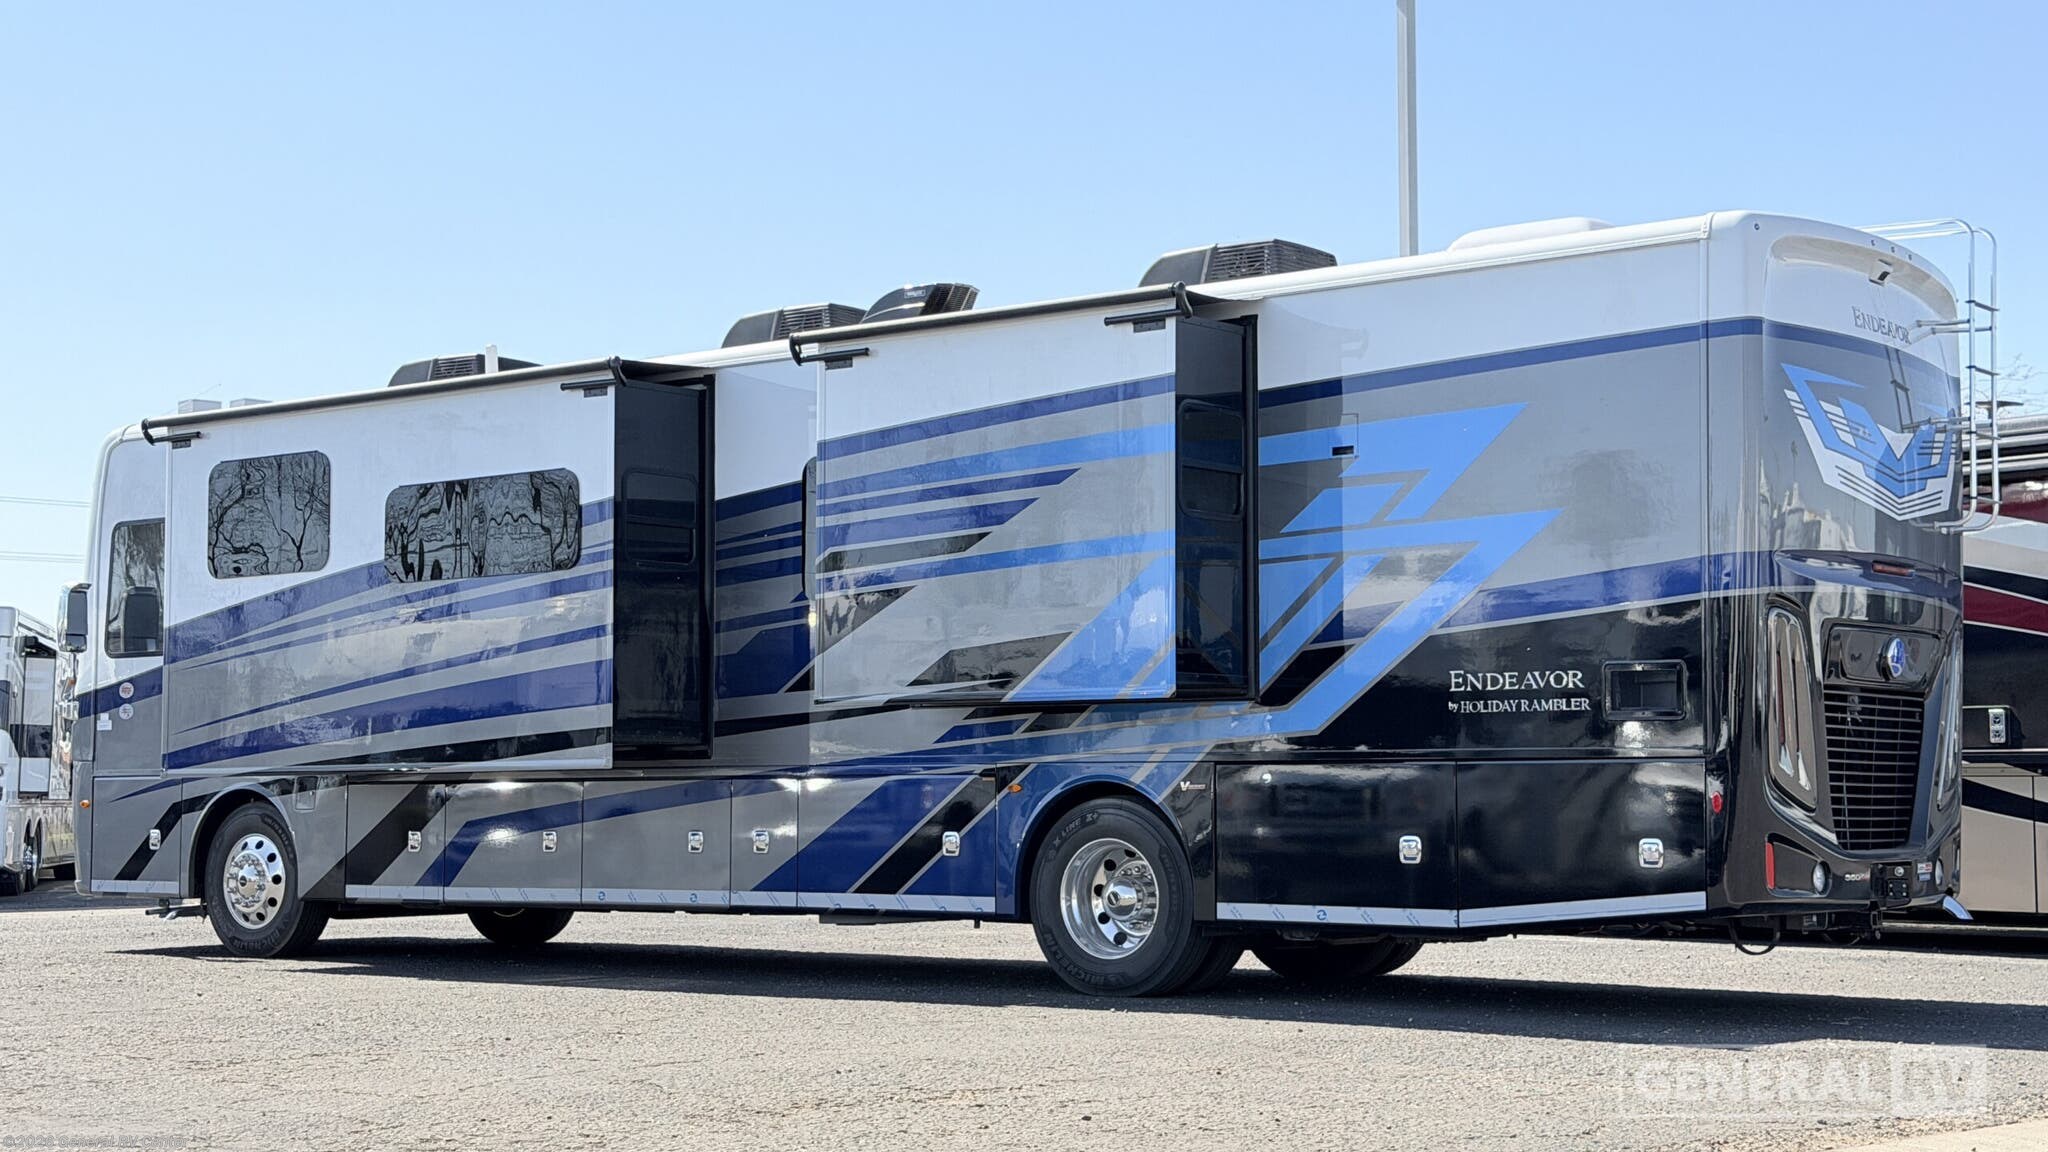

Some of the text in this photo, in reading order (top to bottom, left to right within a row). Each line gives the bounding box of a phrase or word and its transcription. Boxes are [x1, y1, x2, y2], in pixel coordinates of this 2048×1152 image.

[1851, 305, 1911, 345] ENDEAVOR
[1449, 670, 1585, 692] ENDEAVOR
[1448, 698, 1591, 713] by HOLIDAY RAMBLER
